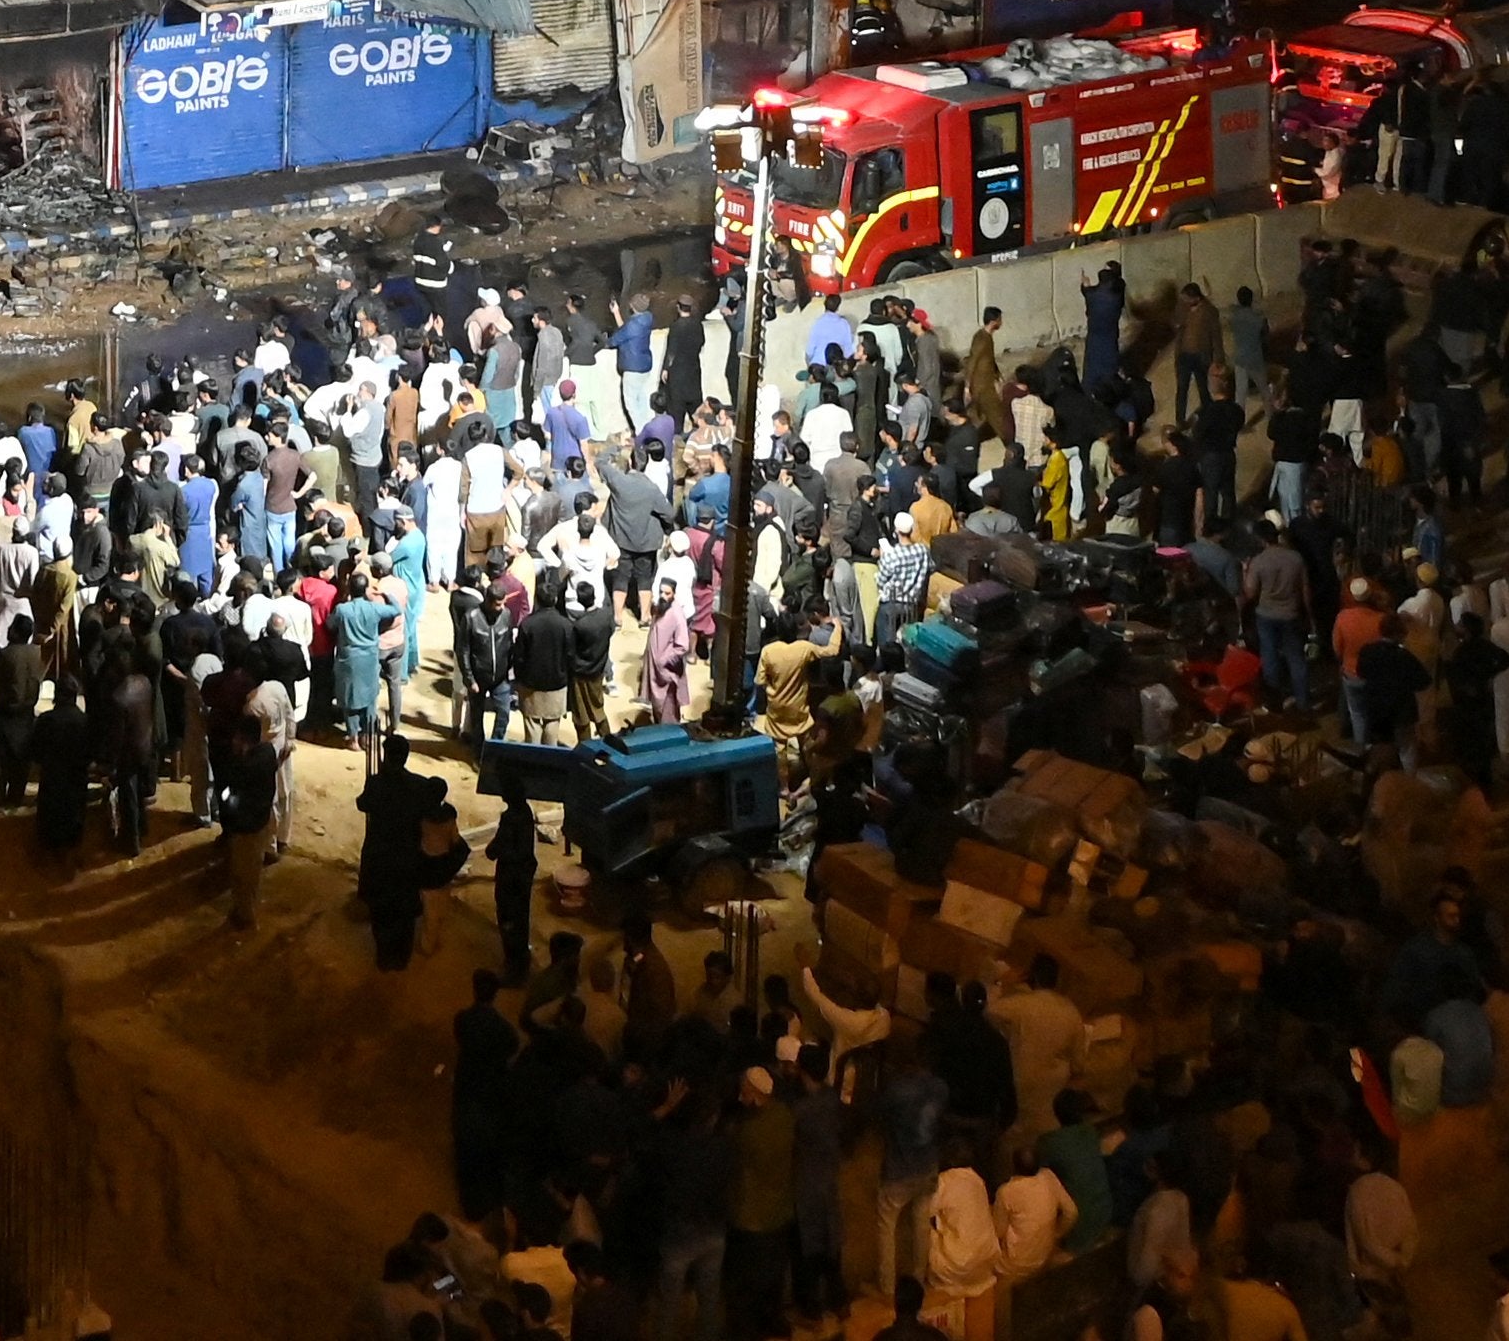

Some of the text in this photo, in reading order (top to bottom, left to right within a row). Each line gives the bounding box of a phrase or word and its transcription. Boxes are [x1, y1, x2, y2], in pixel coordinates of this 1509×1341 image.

[143, 32, 197, 53] LADHANI
[329, 25, 453, 76] GOBI'S
[136, 54, 270, 104] GOBI'S
[365, 70, 416, 87] PAINTS
[175, 95, 230, 114] PAINTS
[788, 219, 810, 237] FIRE
